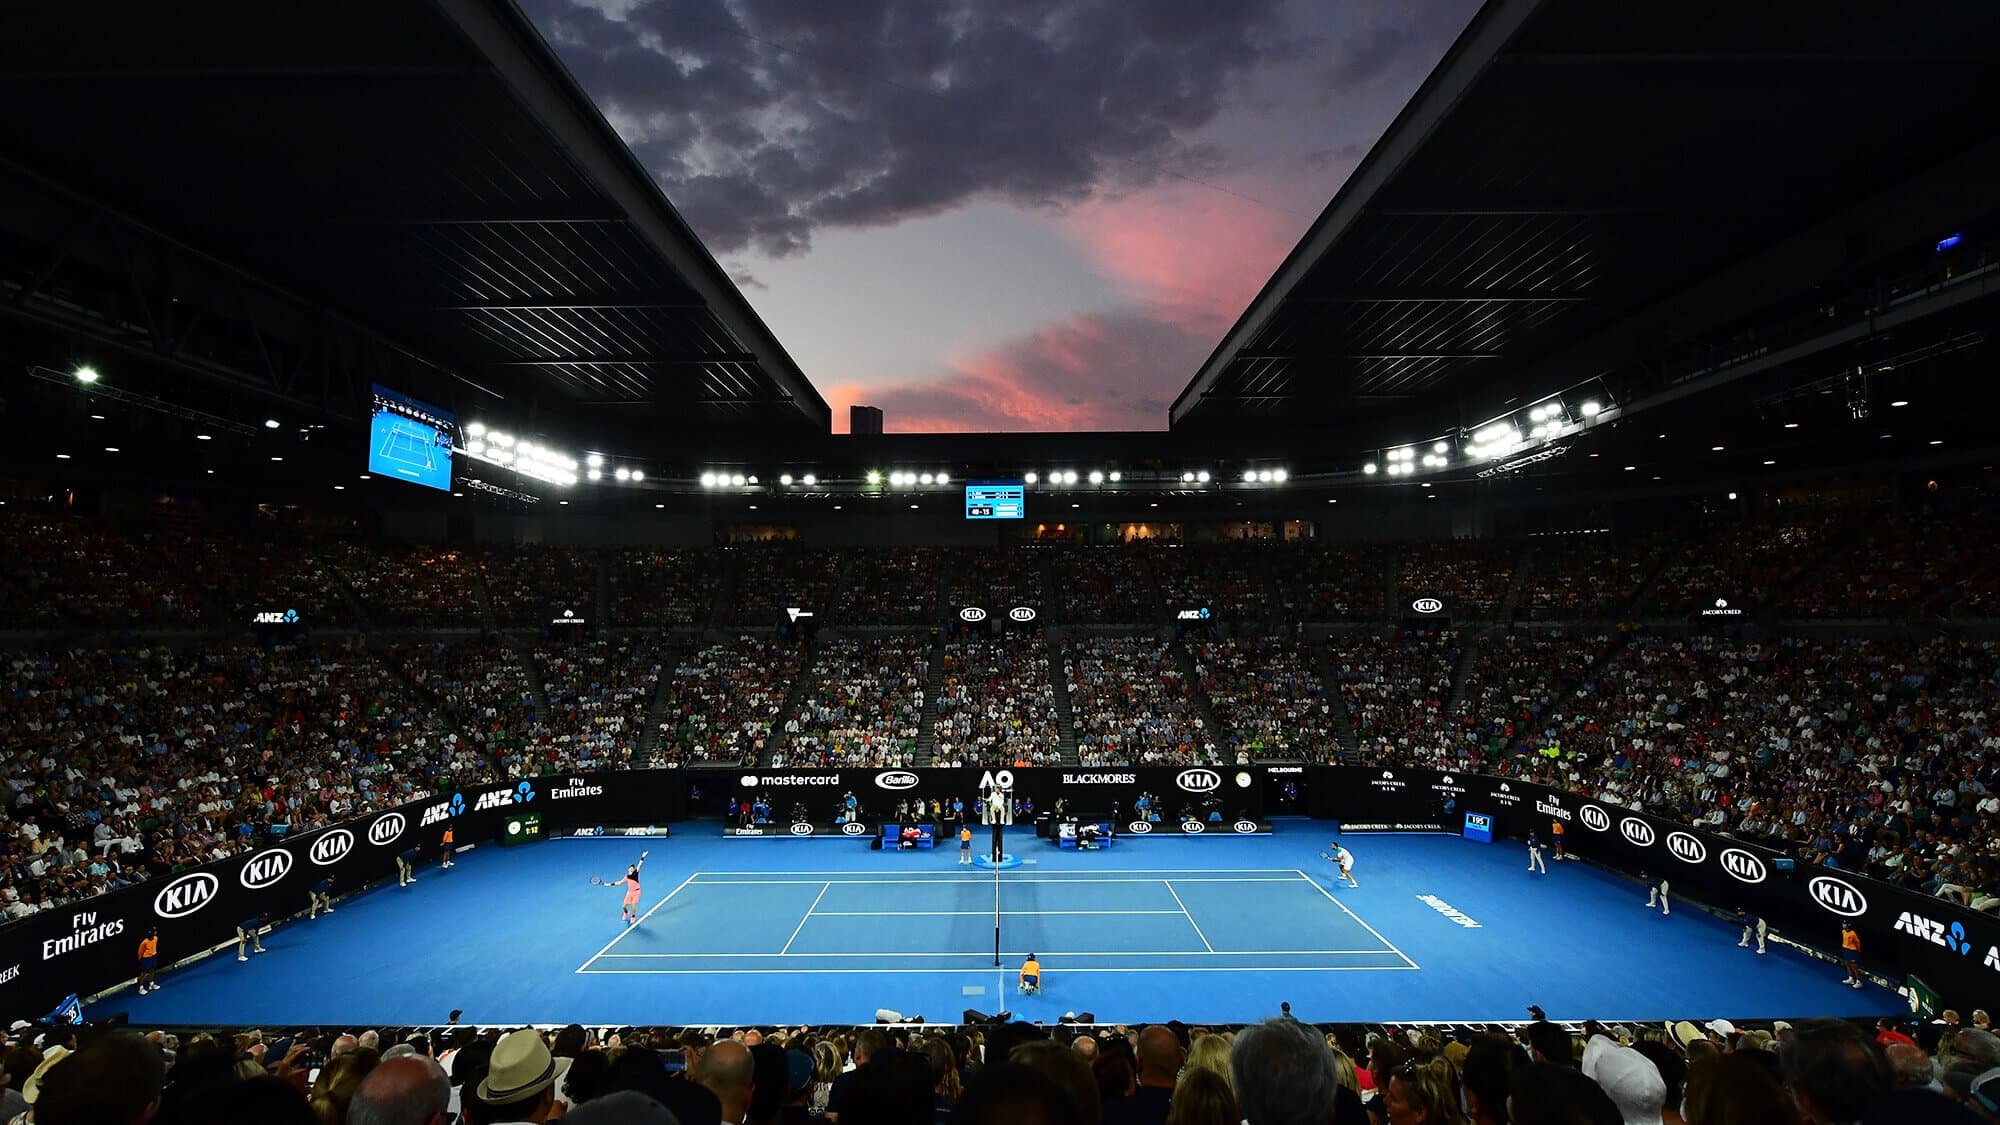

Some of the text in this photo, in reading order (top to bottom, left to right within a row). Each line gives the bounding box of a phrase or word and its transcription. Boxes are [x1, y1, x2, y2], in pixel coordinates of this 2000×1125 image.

[964, 609, 984, 619] KIA
[1014, 609, 1033, 619] KIA
[1178, 610, 1199, 619] ANZ
[1416, 601, 1439, 611] KIA
[253, 613, 283, 623] ANZ
[570, 778, 584, 786] Fly
[761, 774, 839, 785] mastercard
[885, 775, 915, 785] Barilla
[979, 770, 1014, 789] AO
[1062, 774, 1136, 784] BLACKMORES
[1184, 774, 1213, 787] KIA
[474, 788, 513, 811] ANZ
[551, 786, 602, 799] Emirates
[1549, 794, 1560, 807] Fly
[420, 802, 449, 827] ANZ
[1536, 800, 1572, 821] Emirates
[1585, 811, 1606, 828] KIA
[375, 818, 400, 841] KIA
[573, 828, 595, 836] ANZ
[624, 828, 647, 836] ANZ
[1626, 822, 1650, 843] KIA
[317, 835, 347, 861] KIA
[1673, 837, 1699, 858] KIA
[250, 860, 285, 884] KIA
[1727, 854, 1758, 878] KIA
[166, 880, 209, 912] KIA
[1818, 882, 1857, 912] KIA
[74, 911, 97, 929] Fly
[1893, 911, 1946, 947] ANZ
[43, 919, 124, 960] Emirates
